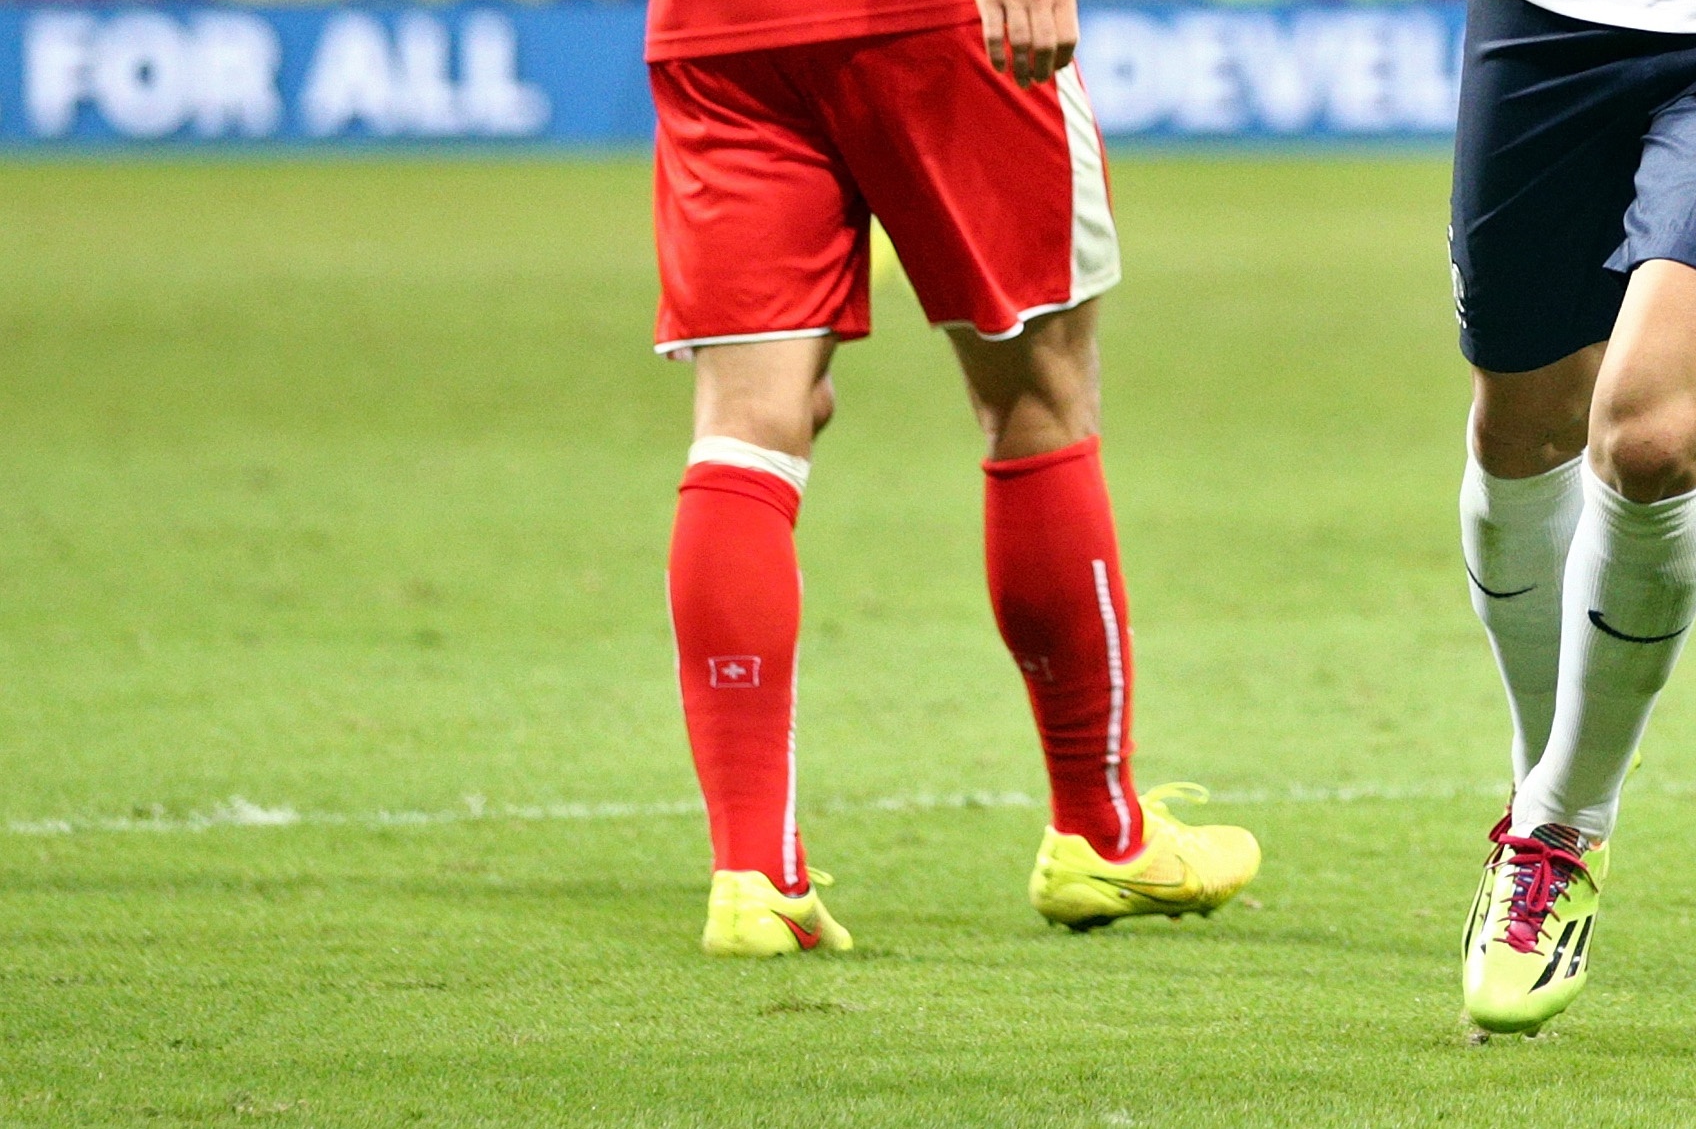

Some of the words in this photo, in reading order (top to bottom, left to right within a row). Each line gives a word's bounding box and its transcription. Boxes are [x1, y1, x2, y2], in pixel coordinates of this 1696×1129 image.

[24, 8, 281, 137] FOR
[301, 8, 551, 137] ALL
[1077, 6, 1464, 134] DEVEL
